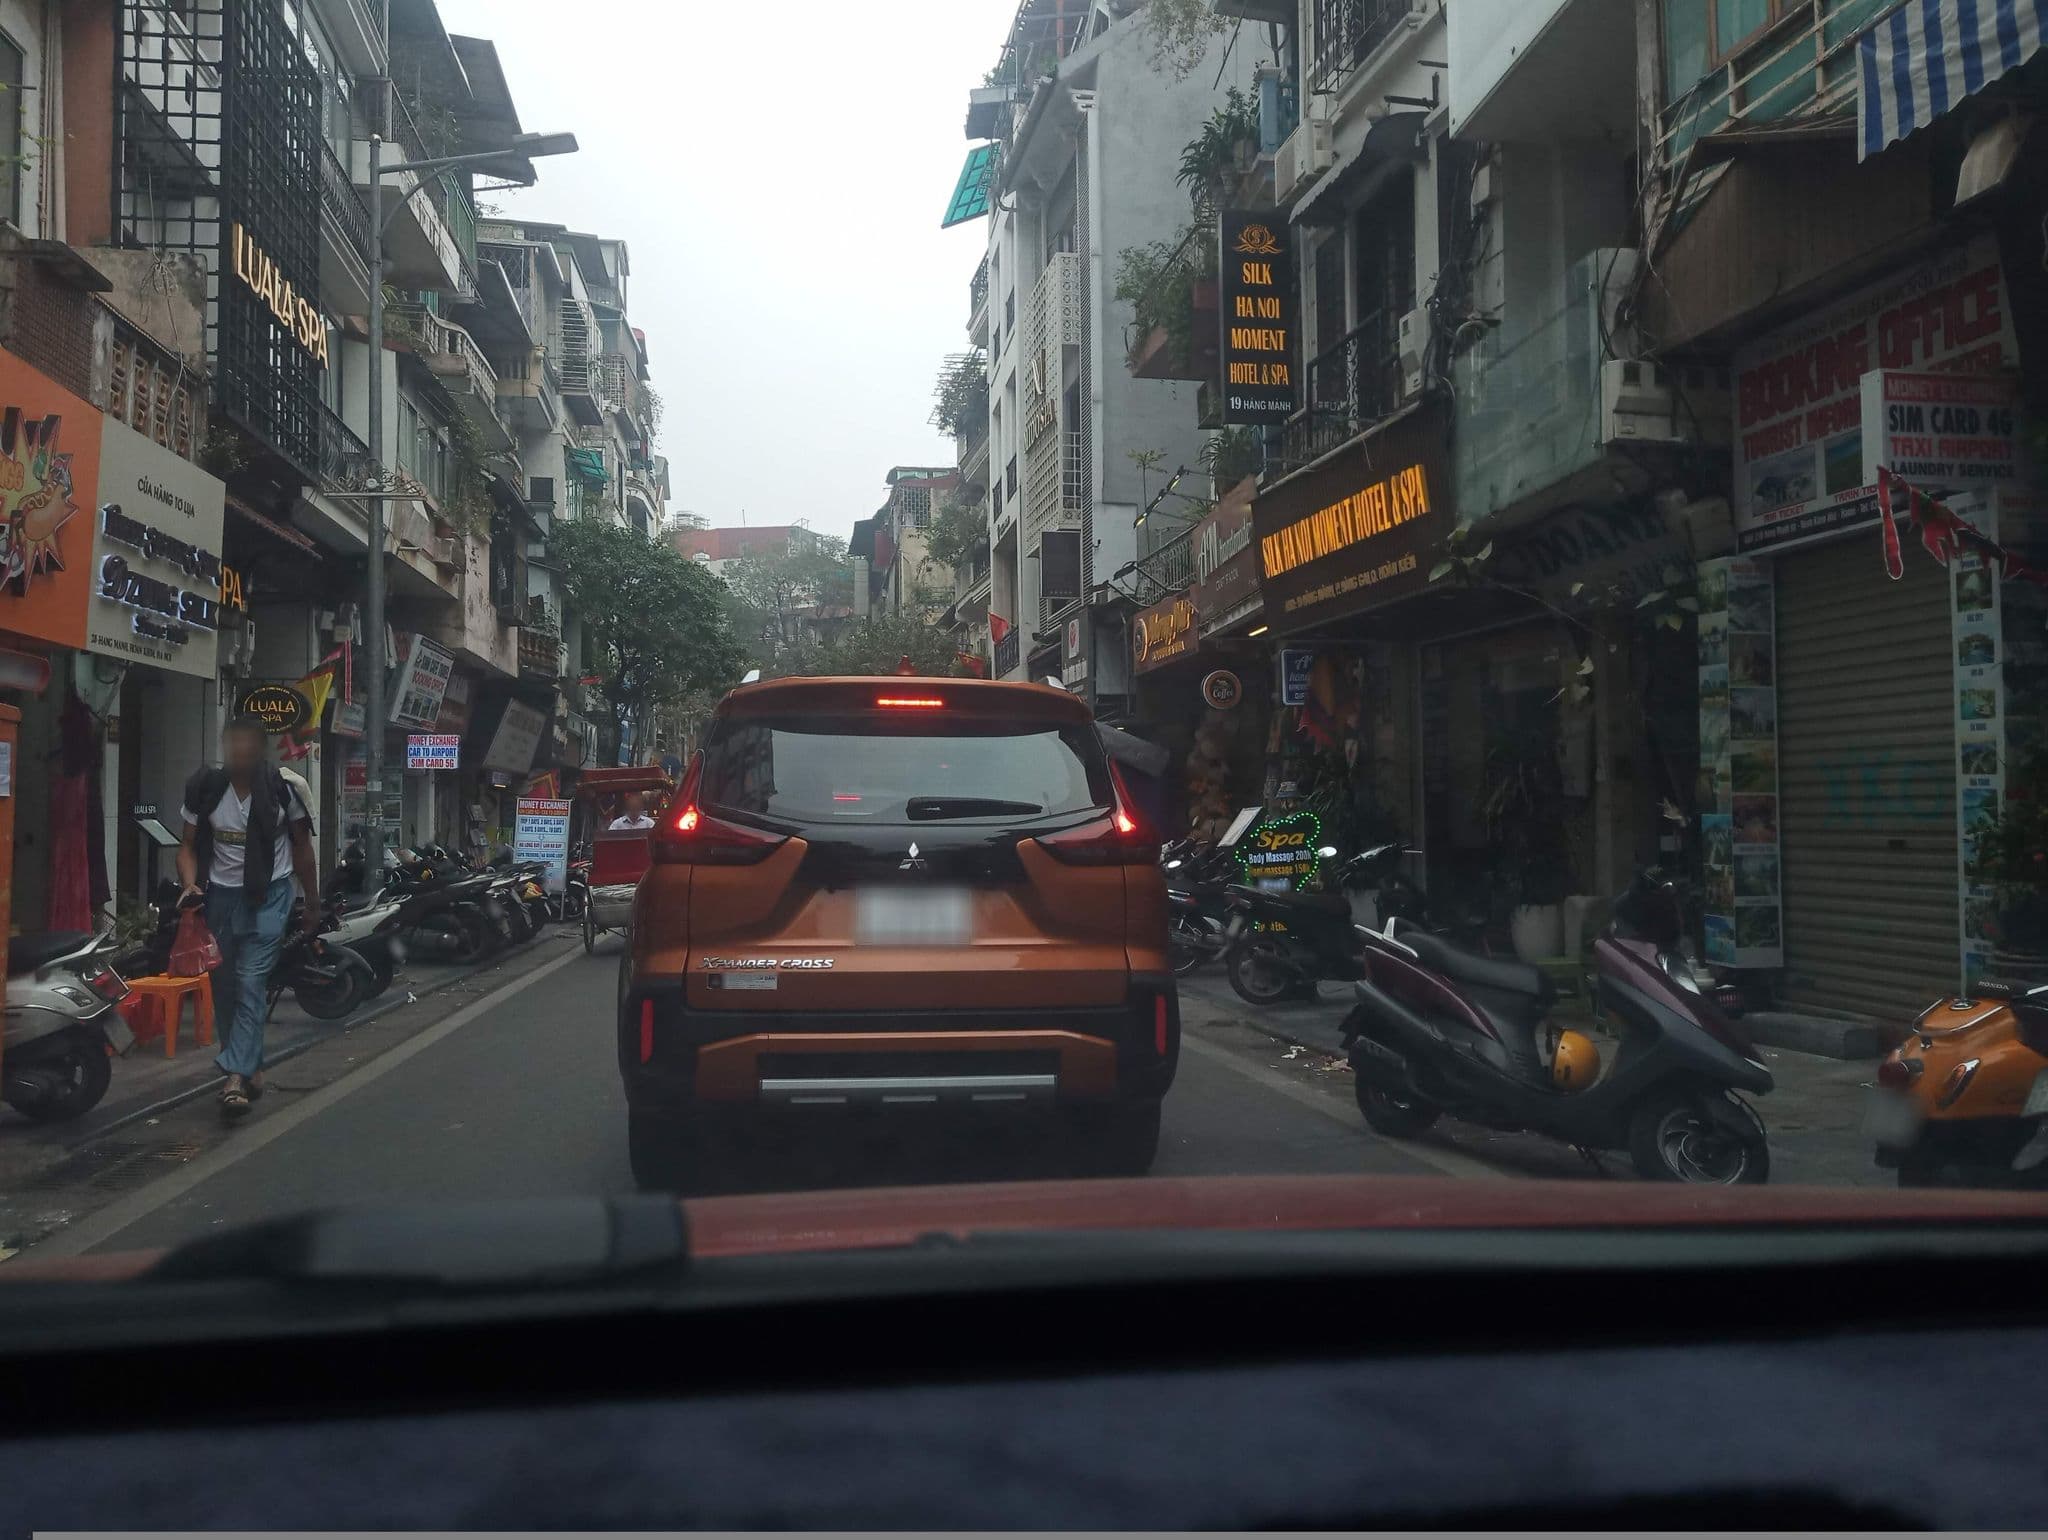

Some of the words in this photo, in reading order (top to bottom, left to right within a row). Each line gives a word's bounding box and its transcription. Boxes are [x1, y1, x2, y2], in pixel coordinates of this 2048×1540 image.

[1243, 262, 1272, 285] SILK
[233, 223, 295, 337] LUALA
[299, 297, 328, 370] SPA
[1236, 296, 1254, 318] HA
[1258, 298, 1280, 319] NOI
[1231, 327, 1286, 351] MOMENT
[1740, 321, 1868, 429] BOOKING
[1878, 264, 2002, 369] OFFICE
[1230, 362, 1259, 385] HOTEL
[1261, 364, 1269, 385] &
[1271, 364, 1289, 385] SPA
[1887, 379, 1929, 401] MONEY
[1230, 396, 1242, 410] 19
[1888, 404, 1924, 433] SIM
[1930, 405, 1981, 435] CARD
[1988, 408, 2014, 436] 4G
[1890, 437, 1932, 457] TAXI
[1938, 438, 2014, 460] AIRPORT
[1890, 461, 1954, 477] LAUNDRY
[1958, 463, 2016, 481] SERVICE
[1262, 531, 1284, 579] SILK
[1280, 525, 1297, 572] HA
[1293, 517, 1314, 567] NOI
[1310, 497, 1354, 560] MOMENT
[1352, 481, 1392, 541] HOTEL
[1390, 475, 1403, 526] &
[1400, 464, 1428, 521] SPA
[221, 566, 243, 612] PA
[250, 700, 296, 713] LUALA
[261, 713, 282, 723] SPA
[408, 736, 428, 746] MONEY
[429, 736, 458, 747] EXCHANGE
[409, 747, 421, 757] CAR
[422, 747, 430, 757] TO
[431, 747, 457, 757] AIRPORT
[411, 758, 424, 768] SIM
[425, 759, 444, 768] CARD
[445, 759, 455, 768] 5G
[520, 800, 539, 809] MONEY
[540, 800, 569, 810] EXCHANGE
[1256, 831, 1306, 851] Spa
[1249, 853, 1265, 865] Body
[1266, 851, 1295, 863] Massage
[703, 957, 777, 969] XPANDER
[780, 958, 834, 969] CROSS
[1978, 981, 2010, 991] HONDA
